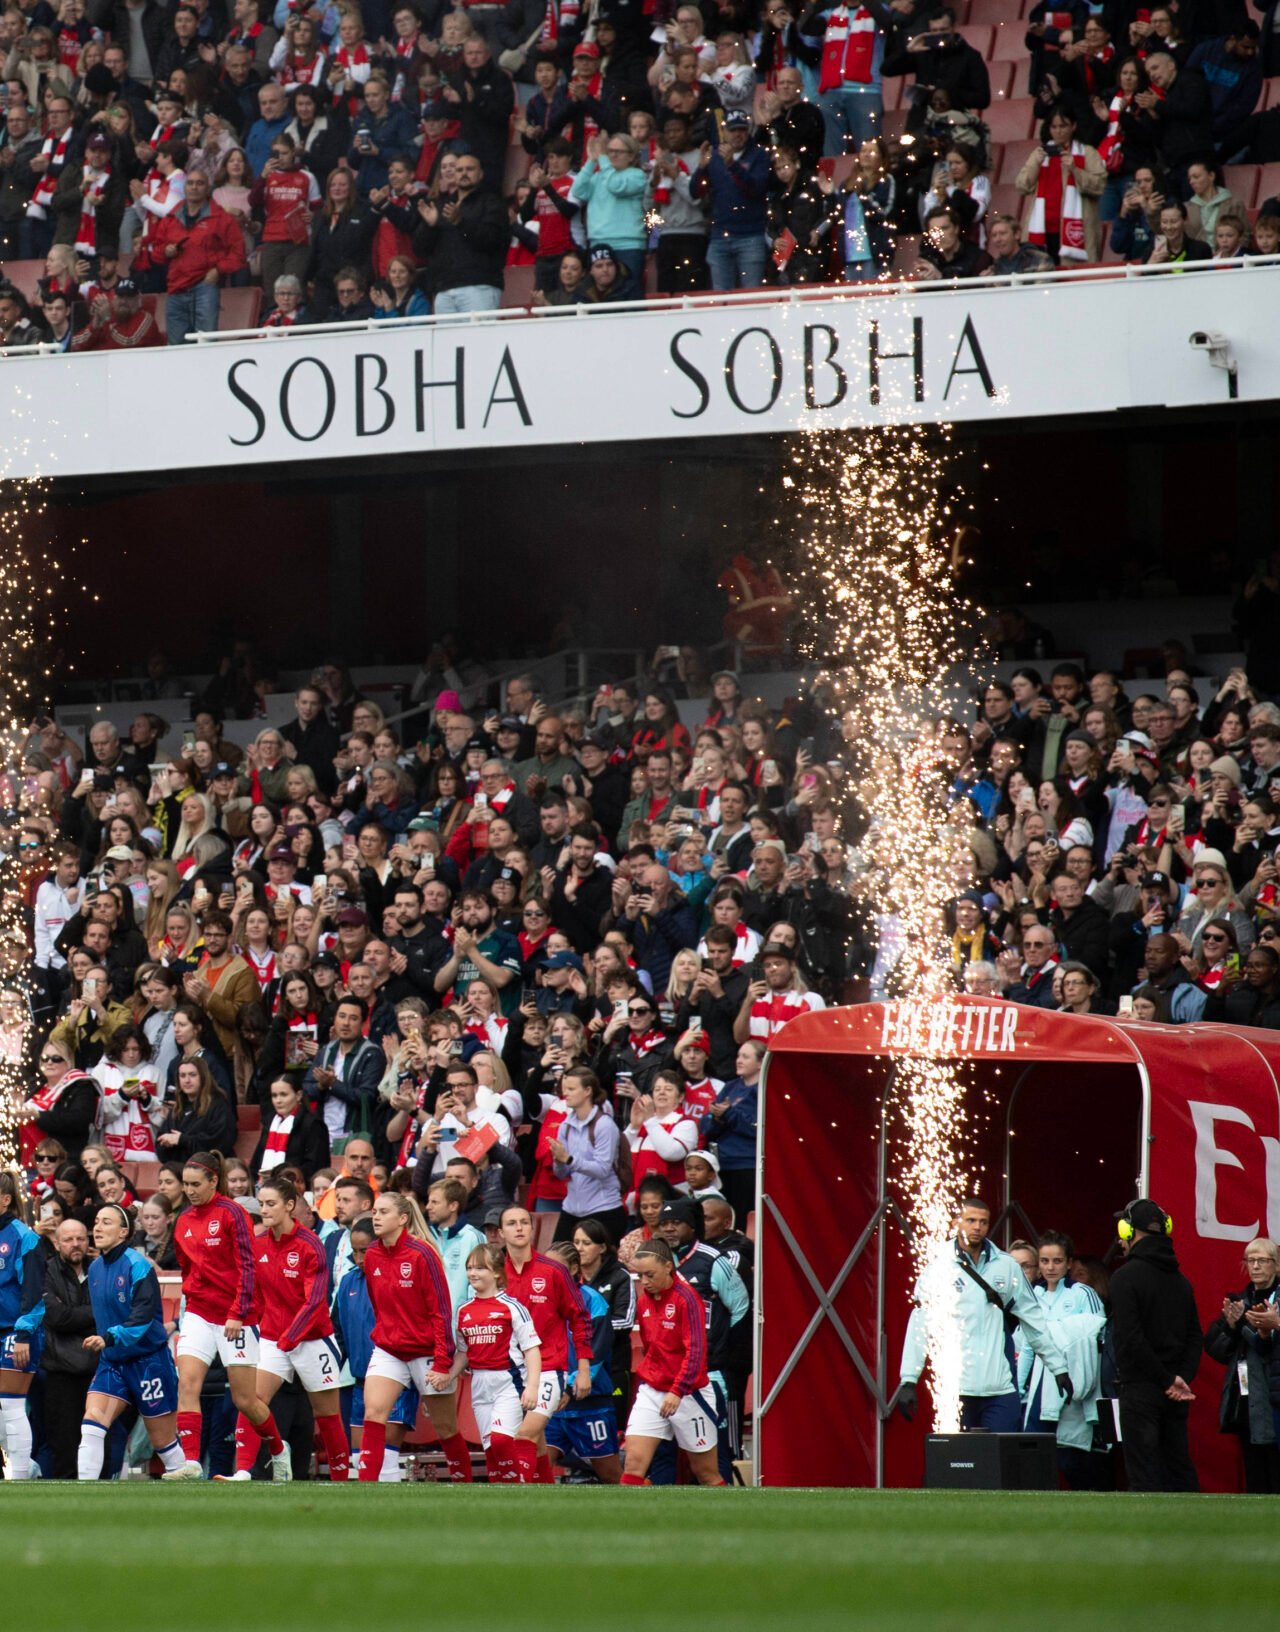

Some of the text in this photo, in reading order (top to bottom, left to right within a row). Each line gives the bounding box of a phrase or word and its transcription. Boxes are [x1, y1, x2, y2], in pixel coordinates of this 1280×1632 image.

[591, 249, 610, 263] AFC
[118, 279, 134, 289] AFC
[669, 312, 998, 419] SOBHA
[227, 343, 533, 447] SOBHA
[927, 1003, 1019, 1052] BETTER
[1186, 1100, 1280, 1242] E
[461, 1325, 503, 1337] Emirates
[477, 1335, 497, 1345] BETTER
[319, 1353, 332, 1375] 2
[140, 1378, 165, 1401] 22
[542, 1382, 553, 1402] 3
[587, 1420, 608, 1441] 10
[691, 1416, 706, 1438] 11
